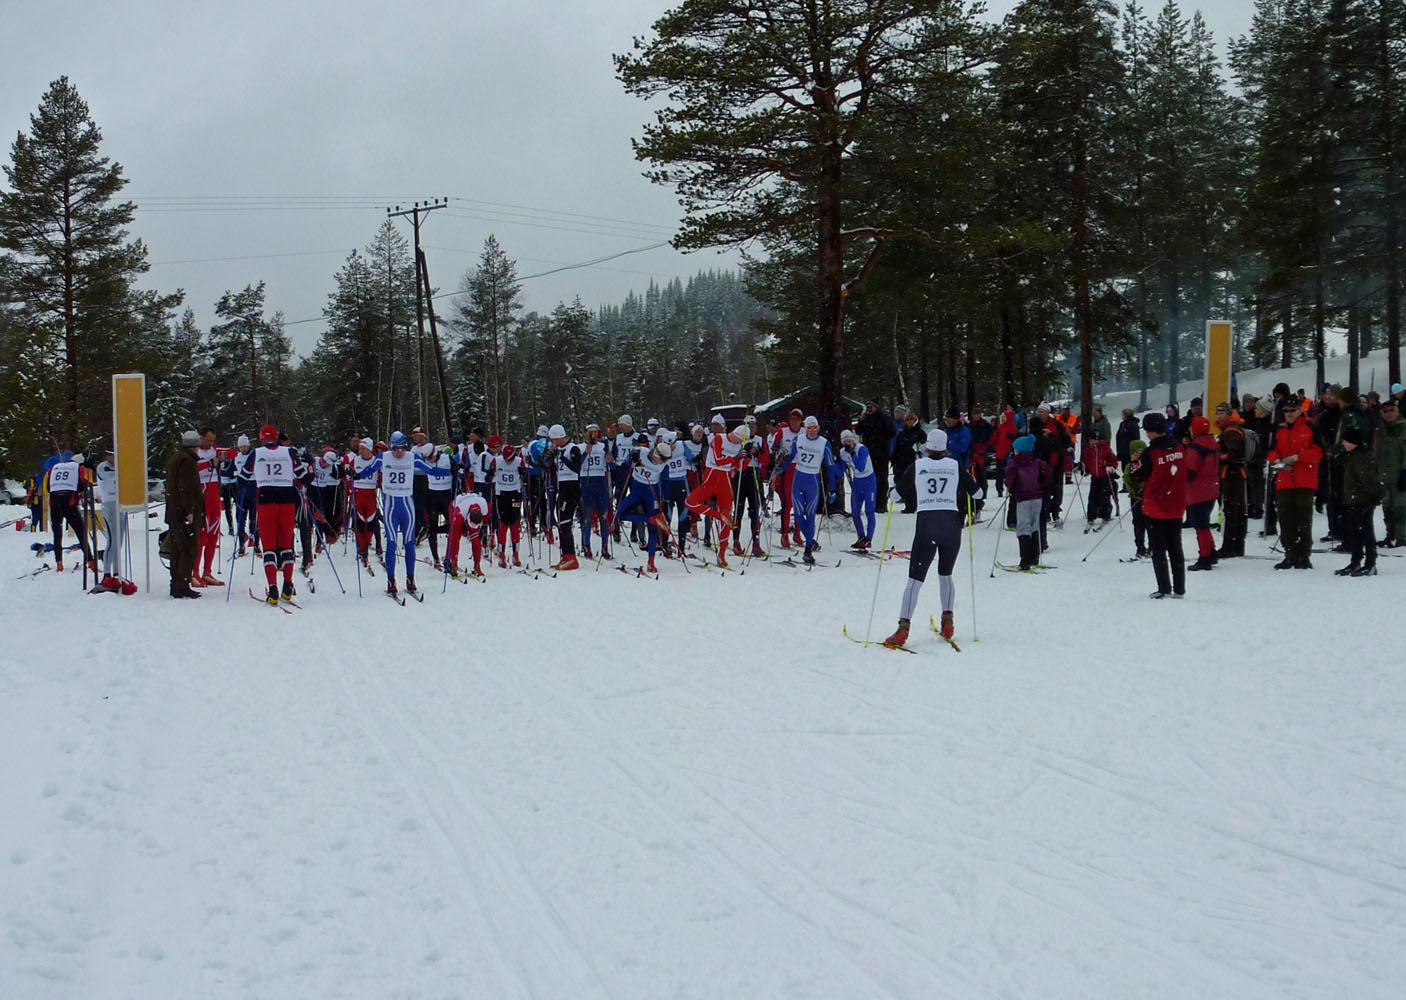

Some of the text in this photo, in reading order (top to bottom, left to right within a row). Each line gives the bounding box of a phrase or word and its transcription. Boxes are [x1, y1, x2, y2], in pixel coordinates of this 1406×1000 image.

[801, 453, 815, 463] 27
[266, 463, 282, 475] 12
[55, 471, 69, 481] 69
[389, 472, 406, 484] 28
[927, 478, 948, 494] 37
